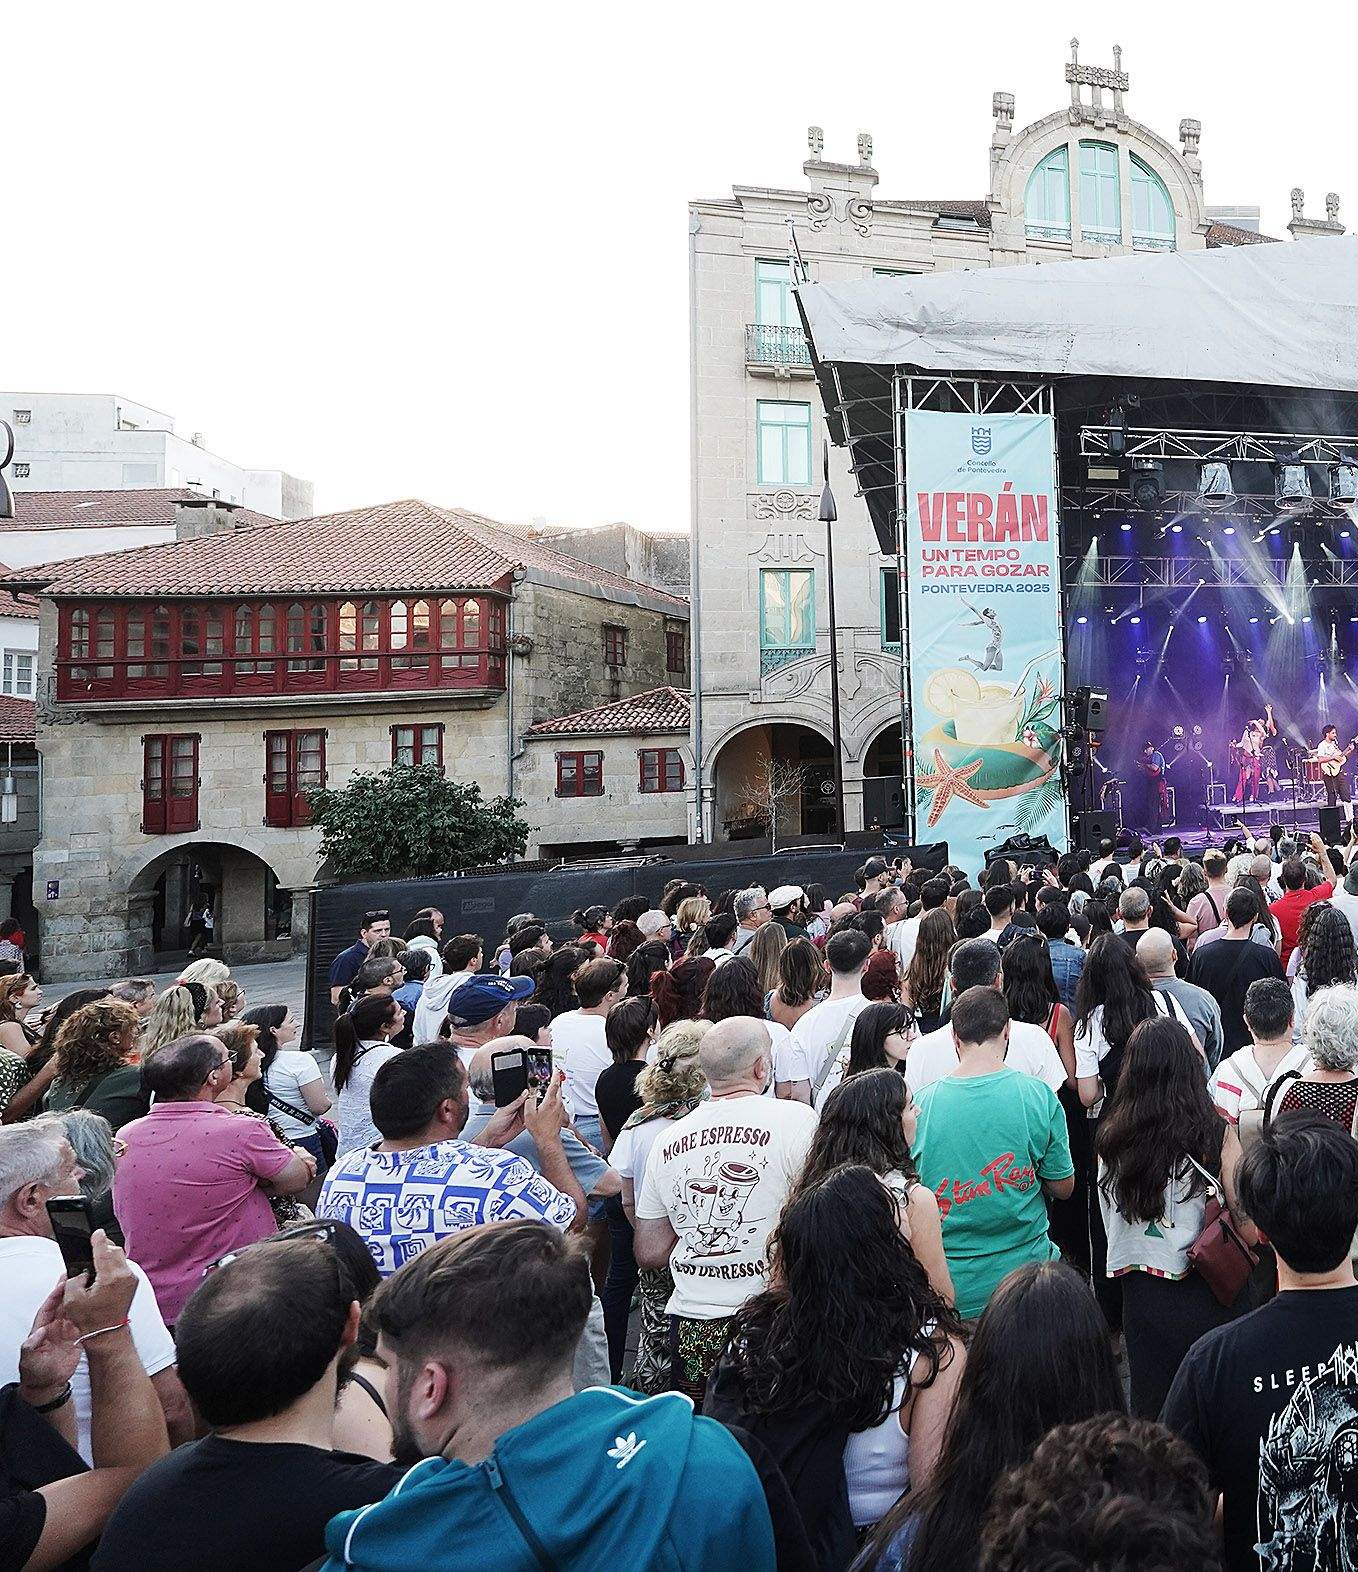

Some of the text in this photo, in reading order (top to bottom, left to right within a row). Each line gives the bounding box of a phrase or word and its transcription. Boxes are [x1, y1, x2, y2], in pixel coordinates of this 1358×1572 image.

[966, 459, 997, 467] Concello
[917, 481, 1049, 542] VERÁN
[921, 548, 1020, 562] UN TEMPO
[922, 563, 1050, 578] PARA GOZAR
[921, 583, 1050, 594] PONTEVEDRA 2025
[662, 1126, 771, 1165] MORE ESPRESSO
[1253, 1362, 1327, 1393] SLEEP
